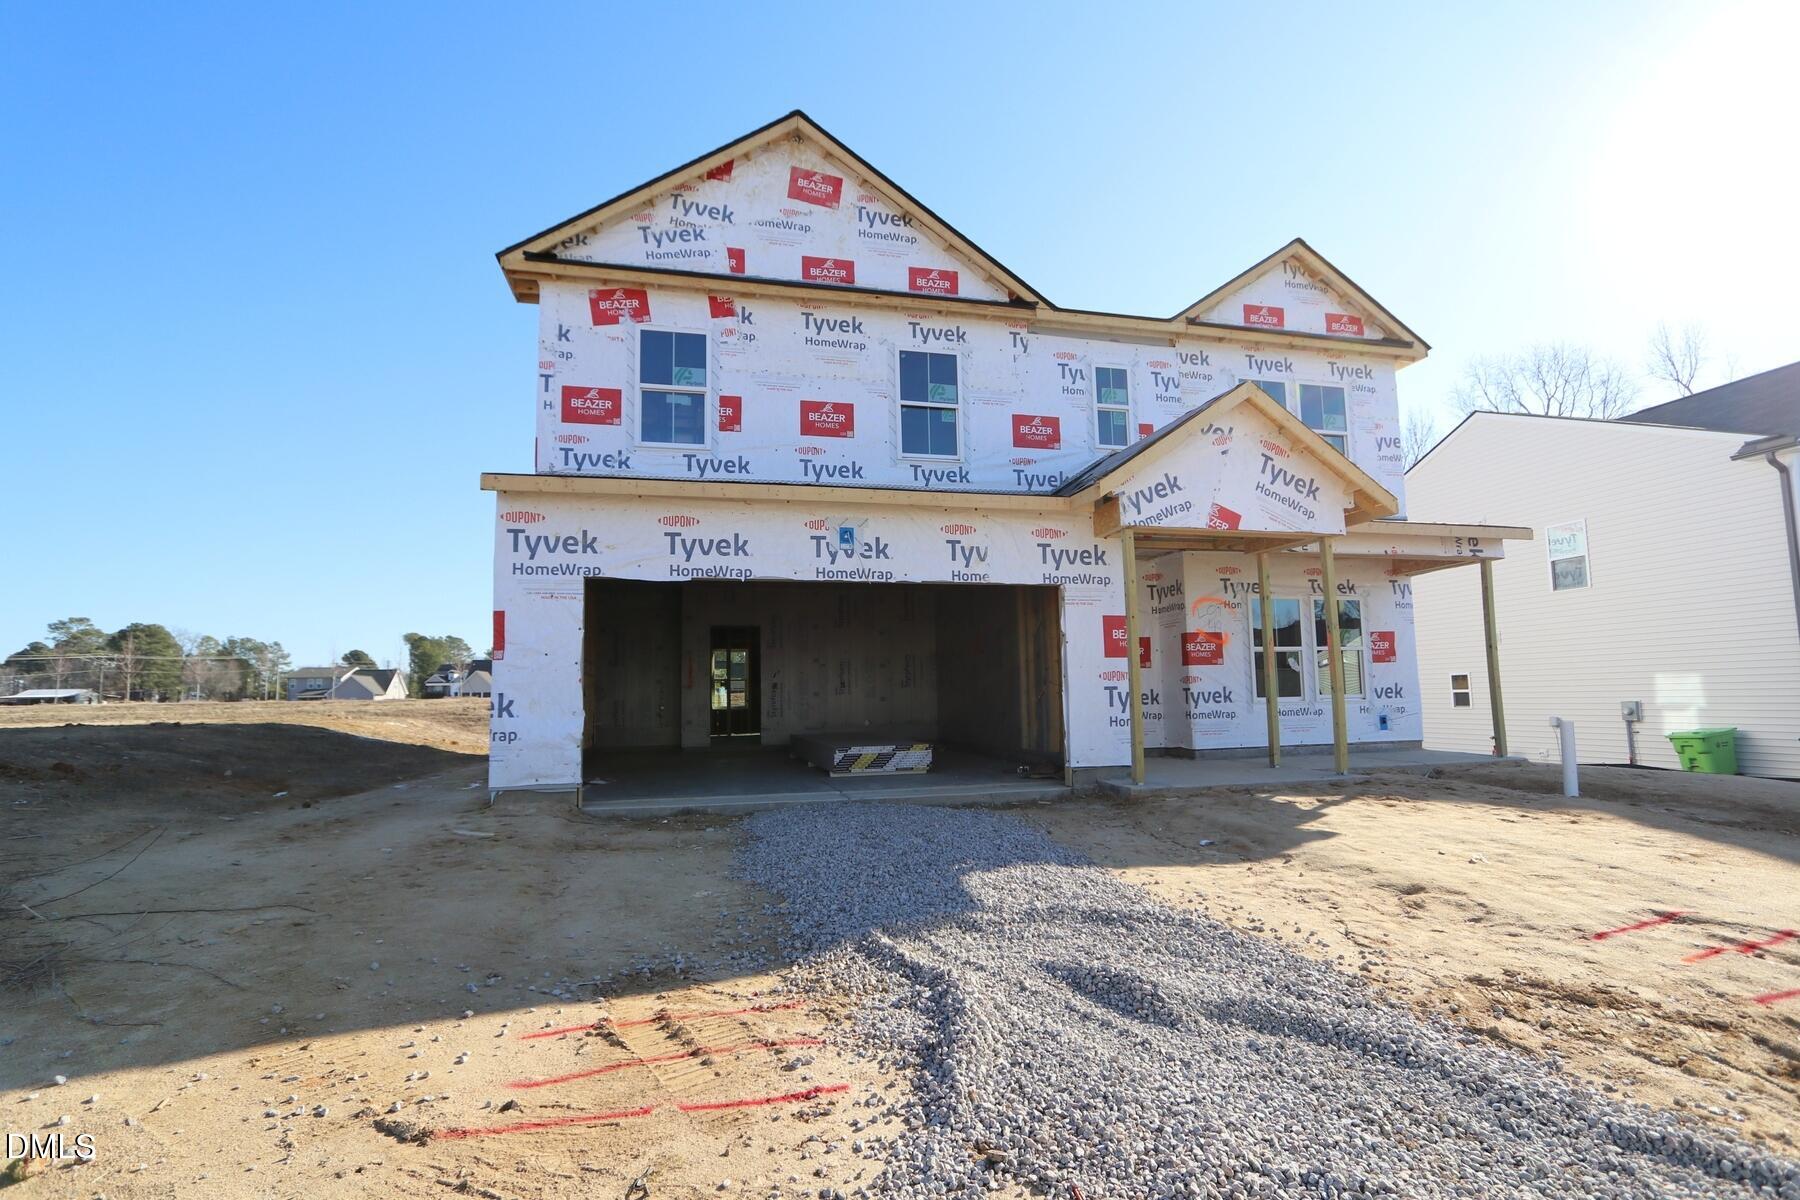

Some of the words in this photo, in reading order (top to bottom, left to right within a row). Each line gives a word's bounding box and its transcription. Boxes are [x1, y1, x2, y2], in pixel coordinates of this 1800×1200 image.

[797, 178, 833, 194] BEAZER
[803, 188, 826, 199] HOMES
[857, 195, 877, 204] UPONT
[671, 193, 734, 224] Tyvek
[857, 206, 914, 229] Tyvek
[637, 226, 706, 248] Tyvek
[859, 229, 917, 245] HomeWrap
[645, 248, 711, 260] HomeWrap
[810, 267, 847, 278] BEAZER
[916, 278, 951, 289] BEAZER
[599, 299, 640, 310] BEAZER
[801, 312, 864, 335] Tyvek
[1250, 314, 1278, 324] BEAZER
[908, 321, 967, 344] Tyvek
[1331, 322, 1358, 332] BEAZER
[805, 336, 866, 351] HomeWrap
[1176, 350, 1210, 366] vek
[1245, 354, 1293, 374] Tyvek
[1328, 361, 1373, 380] Tyvek
[1151, 371, 1180, 392] Tyv
[570, 398, 612, 409] BEAZER
[1155, 394, 1182, 404] Home
[808, 412, 846, 422] BEAZER
[1020, 425, 1053, 435] BEAZER
[558, 434, 586, 444] DUPONT
[798, 446, 823, 456] DUPONT
[1262, 439, 1288, 459] DUPONT
[559, 447, 632, 471] Tyvek
[682, 454, 751, 477] Tyvek
[1012, 458, 1034, 466] DUPONT
[799, 458, 864, 482] Tyvek
[910, 464, 970, 487] Tyvek
[1260, 452, 1320, 501] Tyvek
[1255, 481, 1316, 520] HomeWrap
[505, 511, 541, 524] DUPONT
[663, 515, 696, 527] DUPONT
[944, 523, 973, 535] DUPONT
[1035, 528, 1062, 539] DUPONT
[506, 528, 598, 560] Tyvek
[664, 532, 750, 562] Tyvek
[946, 539, 989, 568] Tyv
[1037, 543, 1107, 571] Tyvek
[512, 563, 602, 577] HomeWrap
[669, 564, 752, 579] HomeWrap
[816, 567, 893, 582] HomeWrap
[951, 570, 990, 582] Home
[1043, 573, 1111, 587] HomeWrap
[1147, 579, 1182, 604] Tyvek
[1219, 577, 1260, 599] Tyve
[1389, 580, 1412, 599] Tyv
[1186, 642, 1216, 651] BEAZER
[1182, 686, 1233, 709] Tyvek
[1374, 682, 1404, 699] vek
[1185, 710, 1236, 721] HomeWrap
